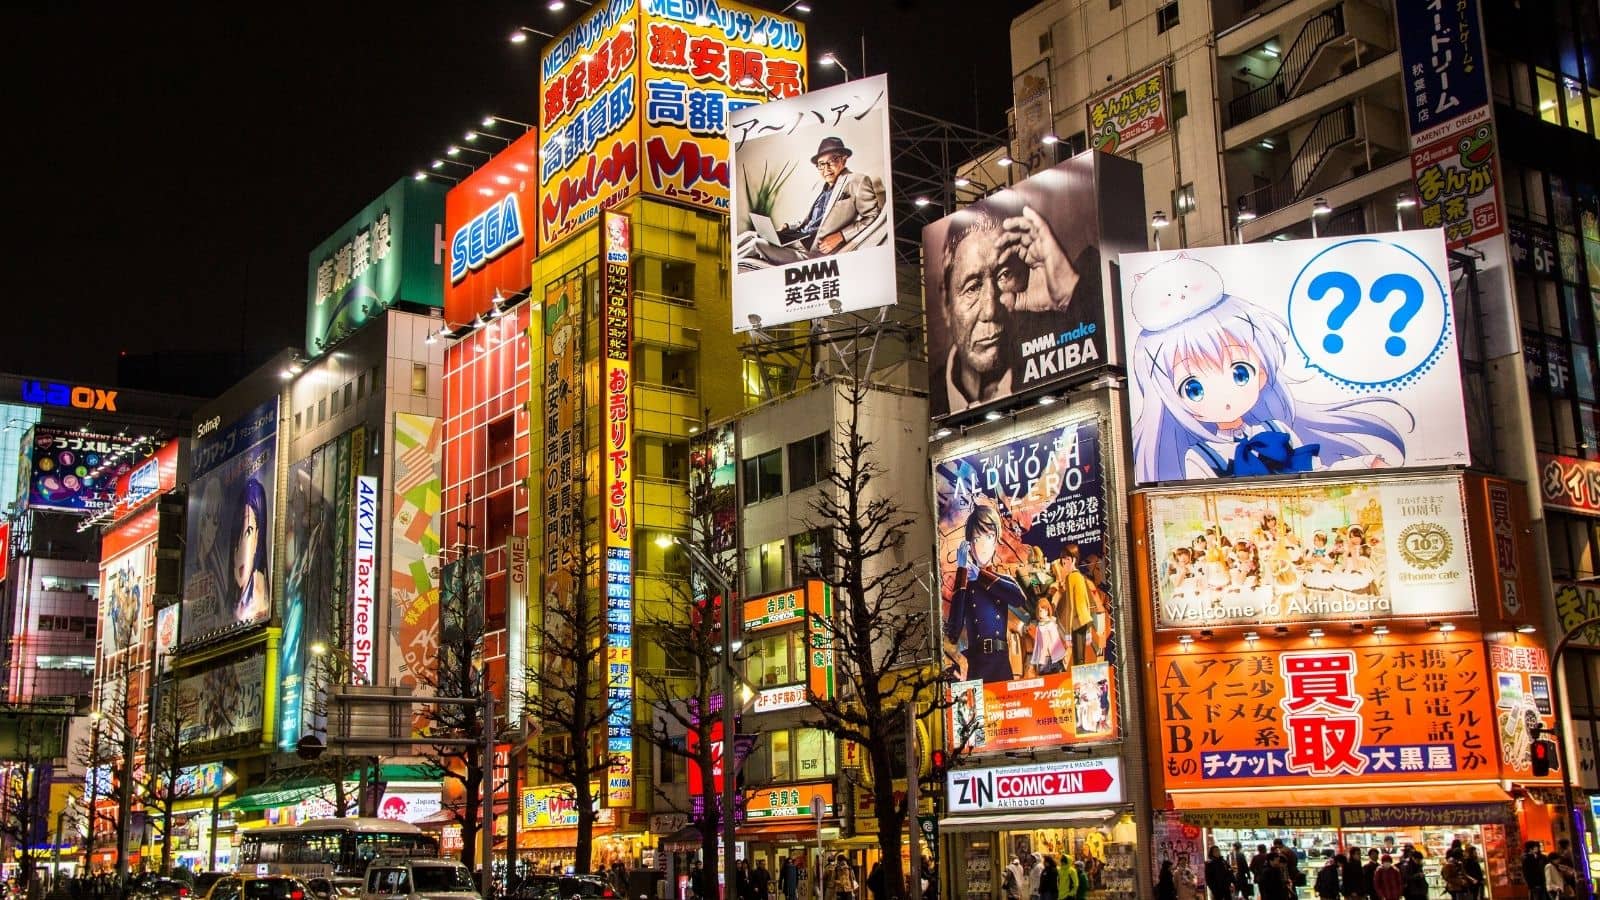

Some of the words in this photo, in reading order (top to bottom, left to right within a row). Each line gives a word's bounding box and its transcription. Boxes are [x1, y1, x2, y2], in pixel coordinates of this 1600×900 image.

[647, 0, 802, 50] MEDIAリサイクル
[543, 27, 635, 128] 激安販売
[648, 24, 802, 98] 激安販売
[1091, 76, 1161, 128] まんが喫茶
[1412, 63, 1430, 122] 秋葉原店
[541, 74, 635, 186] 高額買取
[1416, 125, 1450, 145] AMENITY
[1456, 110, 1486, 128] DREAM
[646, 136, 730, 190] Mu
[542, 140, 639, 242] Mulan
[665, 184, 714, 204] ムーラン
[715, 196, 730, 209] AK
[1417, 163, 1493, 203] まんが
[551, 218, 578, 243] ムーラン
[578, 204, 598, 224] AKIBA
[1421, 196, 1468, 229] 喫茶
[451, 192, 524, 284] SEGA
[608, 264, 627, 276] DVD
[784, 259, 840, 287] DMM
[1533, 246, 1555, 274] 6F
[608, 287, 627, 297] ゲーム
[611, 297, 624, 306] CD
[784, 278, 840, 307] 英会話
[608, 306, 627, 318] アイドル
[608, 317, 627, 328] アニメ
[609, 339, 627, 349] ホビー
[1021, 322, 1097, 359] DMM.make
[1023, 338, 1099, 384] AKIBA
[1547, 362, 1569, 389] 5F
[953, 431, 1081, 500] ALDNOAH
[979, 436, 1066, 476] アルドノア・ゼ
[1010, 467, 1083, 507] ZERO
[359, 480, 375, 537] AKKY
[1031, 496, 1099, 527] コミック第2巻
[1411, 539, 1432, 551] 10
[1490, 486, 1518, 577] 買取
[513, 542, 525, 583] GAME
[1398, 572, 1437, 582] @home
[1439, 570, 1460, 580] cafe
[356, 554, 374, 635] Tax-free
[767, 592, 796, 614] 吉野家
[1164, 601, 1255, 622] Welcome
[1260, 601, 1279, 616] to
[1288, 596, 1390, 615] Akihabara
[1505, 586, 1517, 608] 入口
[1219, 657, 1249, 722] アニメ
[1248, 655, 1281, 748] 美少女系
[1363, 652, 1395, 745] フィギュア
[1391, 650, 1418, 716] ホビー
[1420, 649, 1454, 742] 携帯電話
[1194, 658, 1225, 747] アイドル
[1279, 650, 1371, 778] 買取
[1451, 648, 1488, 771] アップルとか
[1203, 751, 1285, 777] チケット
[1370, 746, 1453, 772] 大黒屋
[610, 779, 631, 788] AKIBA
[770, 789, 800, 807] 吉野家
[953, 771, 994, 809] ZIN
[998, 776, 1055, 798] COMIC
[1058, 772, 1084, 794] ZIN
[998, 798, 1045, 808] Akihabara
[1183, 812, 1214, 820] MONEY
[1217, 811, 1260, 819] TRANSFER
[1267, 810, 1321, 819] WESTERN
[1284, 818, 1321, 826] UNION
